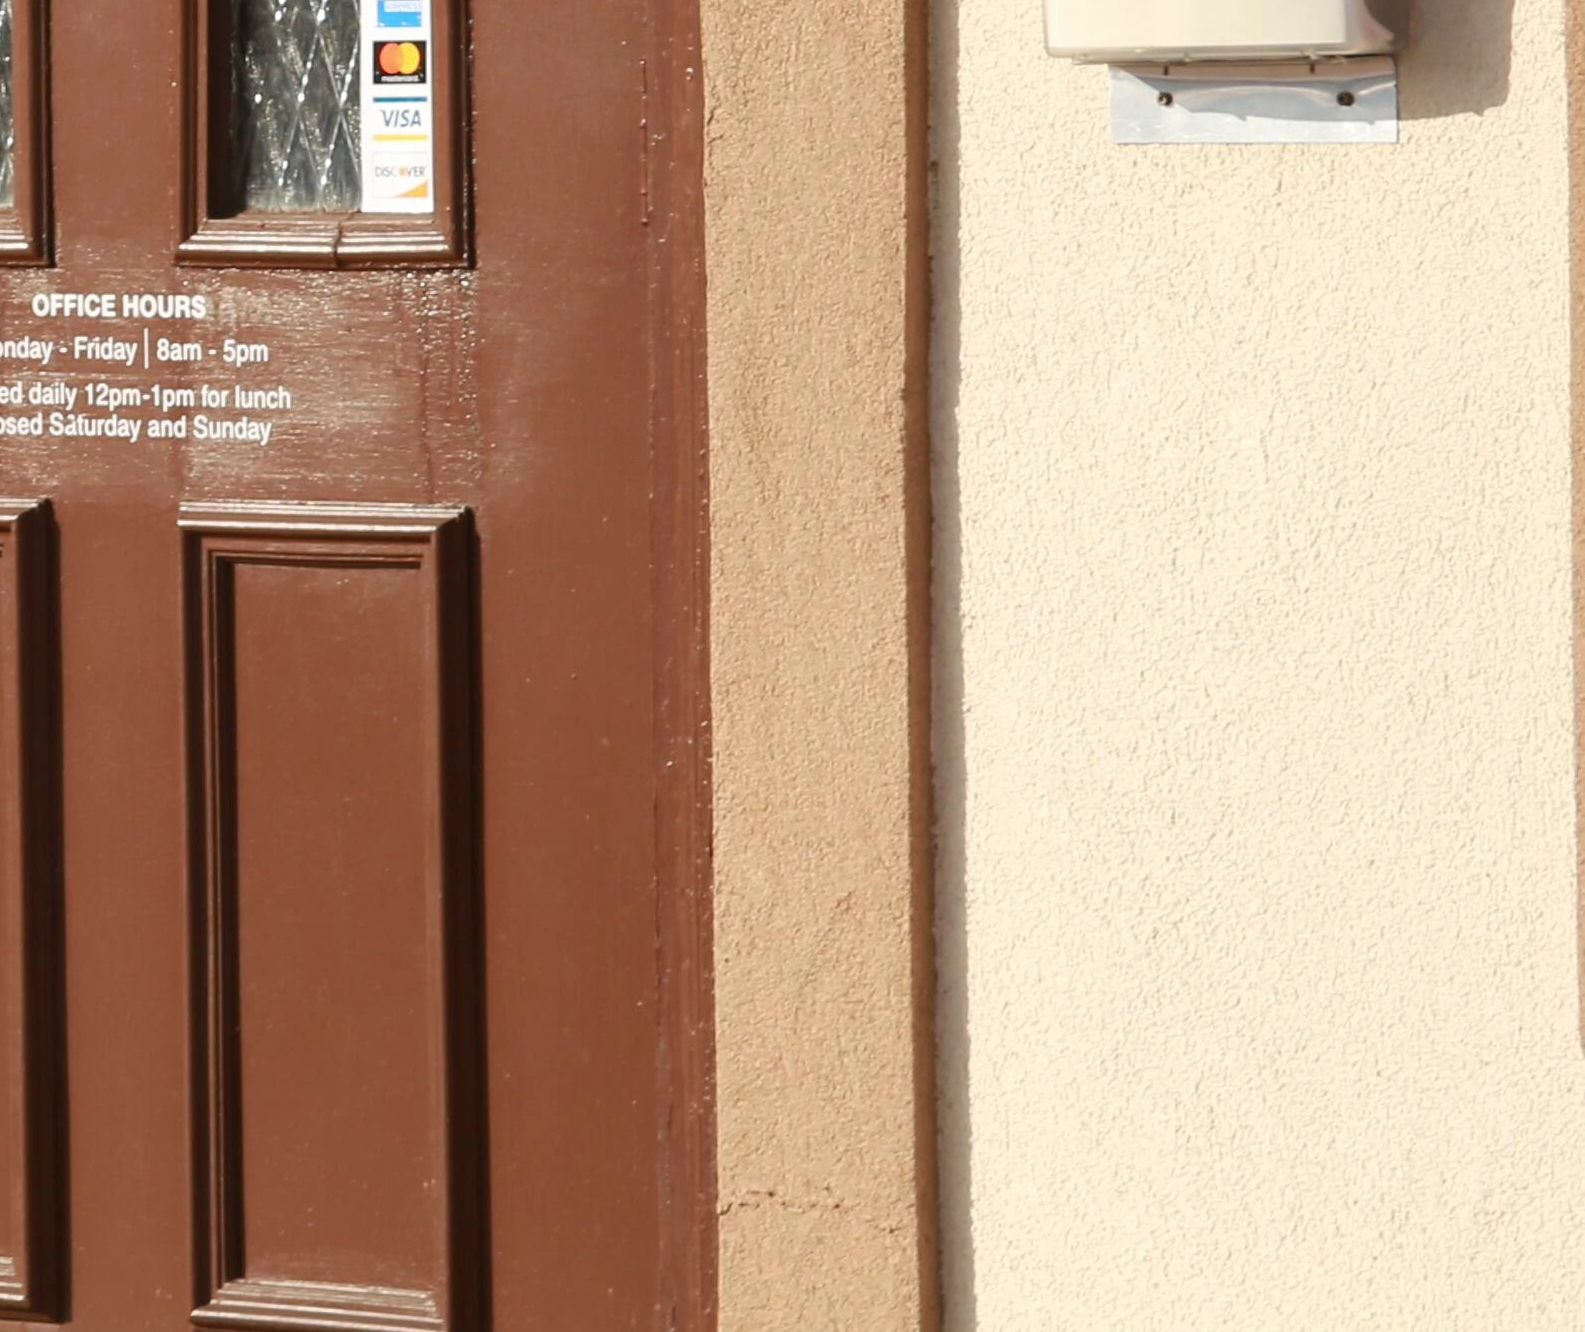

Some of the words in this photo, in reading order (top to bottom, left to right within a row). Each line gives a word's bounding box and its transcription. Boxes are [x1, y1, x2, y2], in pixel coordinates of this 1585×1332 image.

[379, 108, 422, 128] VISA
[32, 293, 117, 318] OFFICE
[123, 294, 207, 319] HOURS
[73, 336, 137, 366] Friday
[156, 338, 202, 362] 8am
[222, 339, 269, 367] 5pm
[28, 381, 77, 410] daily
[84, 383, 195, 412] 12pm-1pm
[201, 384, 229, 409] for
[235, 385, 292, 410] lunch
[48, 412, 141, 443] Saturday
[147, 415, 187, 439] and
[192, 415, 272, 446] Sunday
